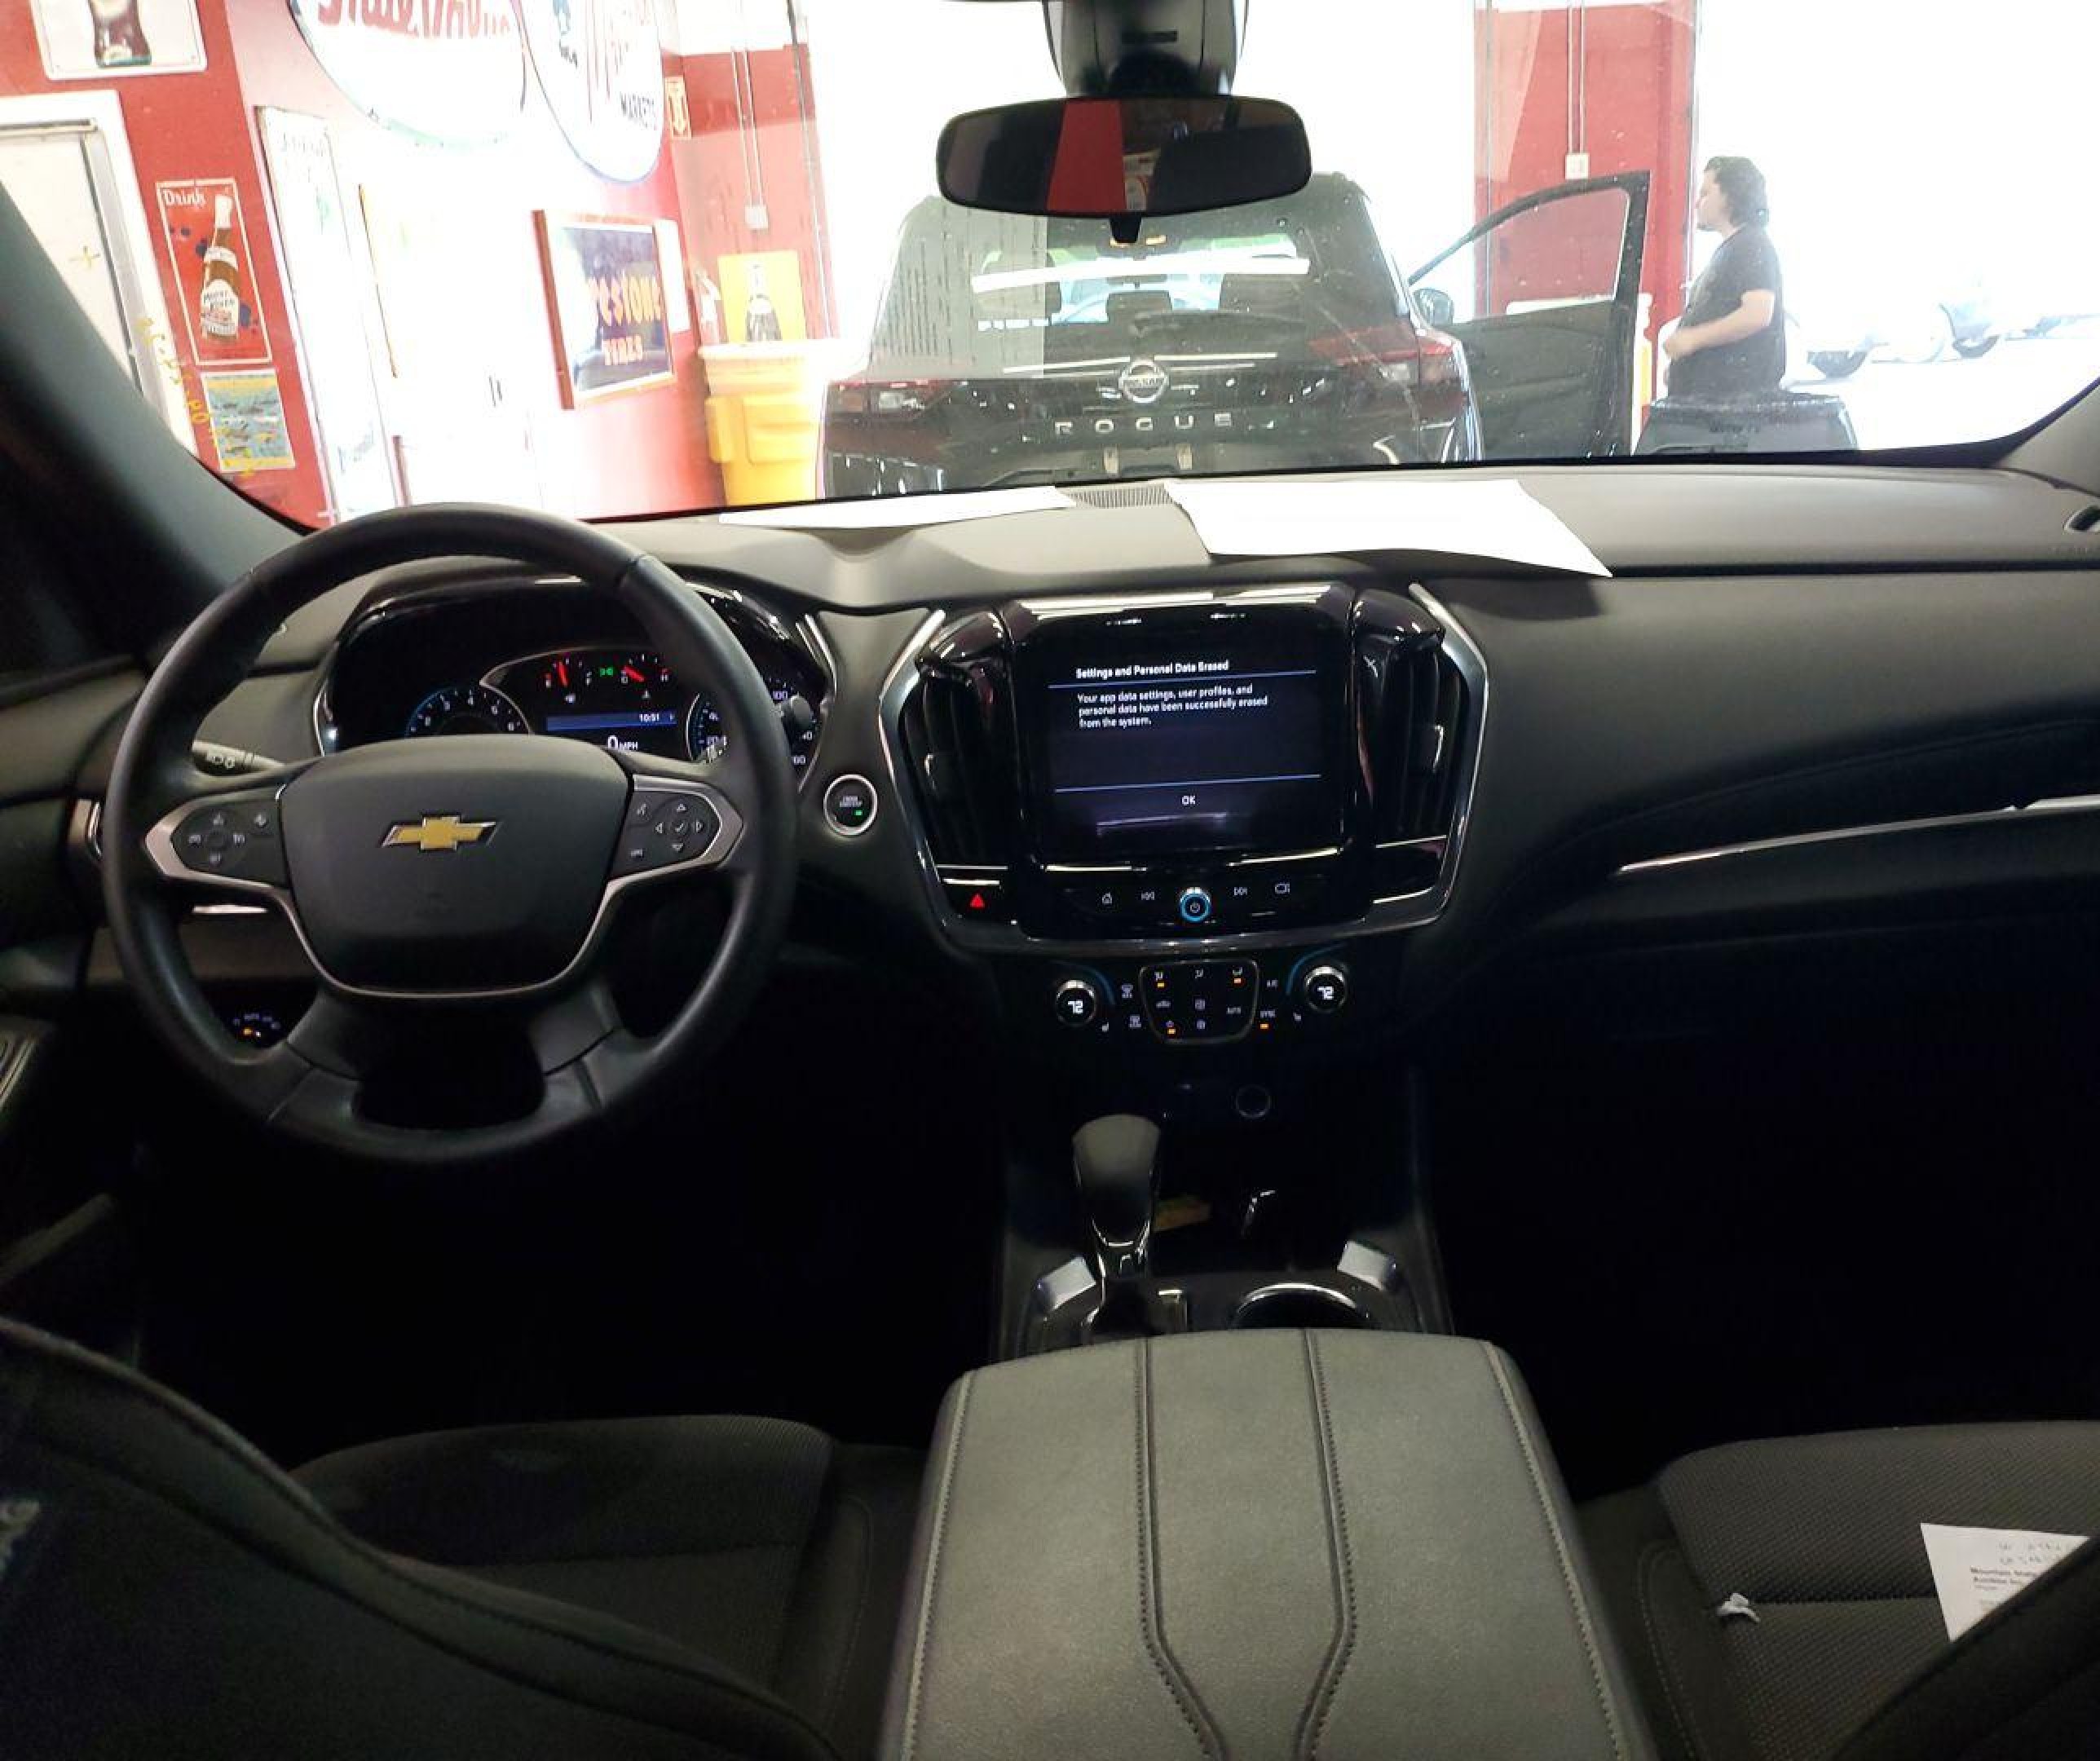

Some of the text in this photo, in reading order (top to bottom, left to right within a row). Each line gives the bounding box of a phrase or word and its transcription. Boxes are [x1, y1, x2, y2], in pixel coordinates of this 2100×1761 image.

[163, 188, 207, 209] Drink
[602, 335, 643, 365] TIRES
[1055, 412, 1233, 435] ROGUE
[1076, 659, 1229, 680] Settings and Personal Data Erased
[1077, 692, 1097, 703] Your
[1101, 694, 1116, 704] app
[1118, 691, 1136, 701] data
[1179, 688, 1197, 699] user
[1236, 682, 1252, 694] and
[1079, 694, 1268, 718] personal data have been successfully erased
[1079, 717, 1101, 728] from
[1102, 717, 1116, 727] the
[607, 734, 619, 749] 0
[1181, 795, 1196, 806] OK
[1317, 985, 1335, 1000] 72
[1067, 1000, 1083, 1015] 72
